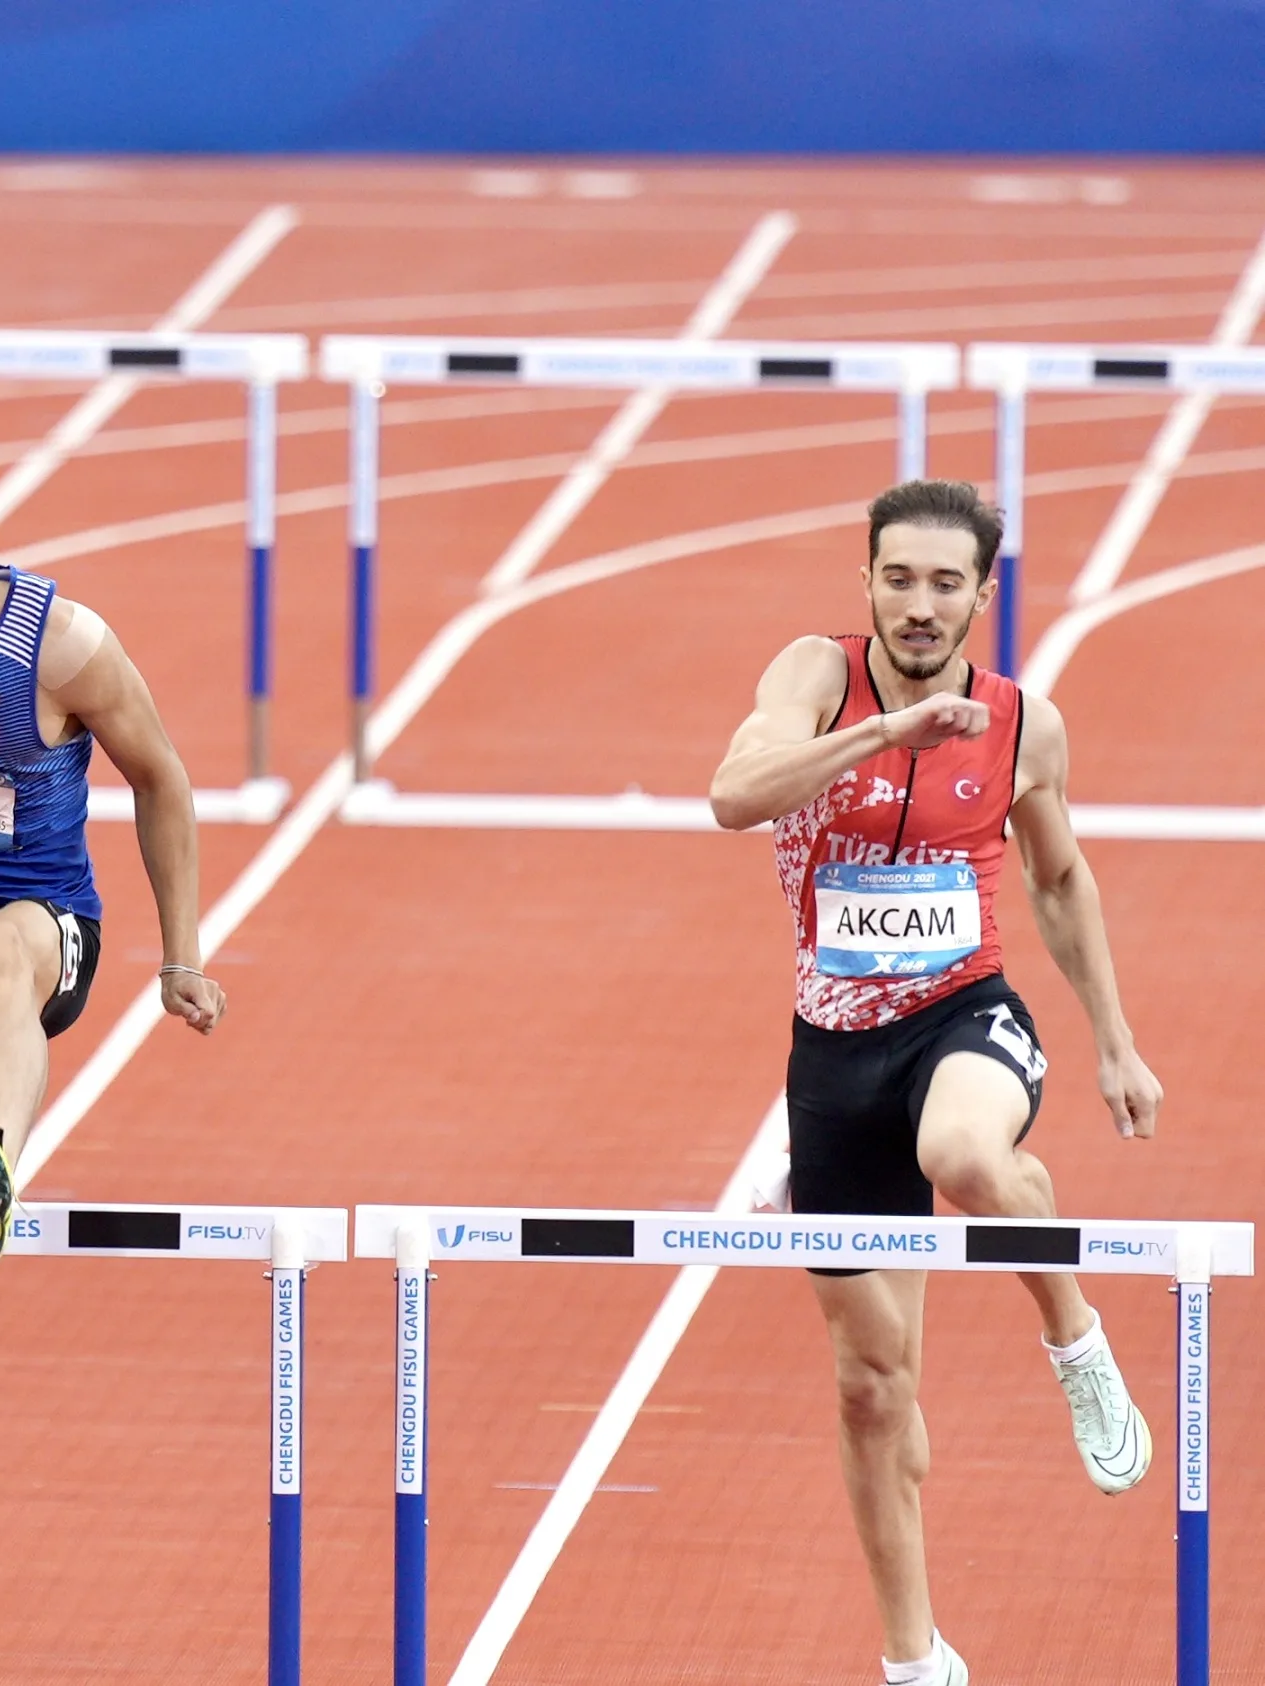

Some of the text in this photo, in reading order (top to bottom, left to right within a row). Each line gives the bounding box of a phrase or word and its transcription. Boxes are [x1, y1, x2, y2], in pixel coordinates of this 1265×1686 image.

[857, 872, 936, 884] CHENGDU 2021
[836, 905, 956, 938] AKCAM
[187, 1225, 267, 1240] FISU.TV
[468, 1230, 513, 1243] FISU
[663, 1230, 938, 1253] CHENGDU FISU GAMES
[1087, 1240, 1168, 1257] FISU.TV
[279, 1278, 294, 1485] CHENGDU FISU GAMES
[401, 1277, 419, 1484] CHENGDU FISU GAMES
[1187, 1293, 1203, 1502] CHENGDU FISU GAMES
